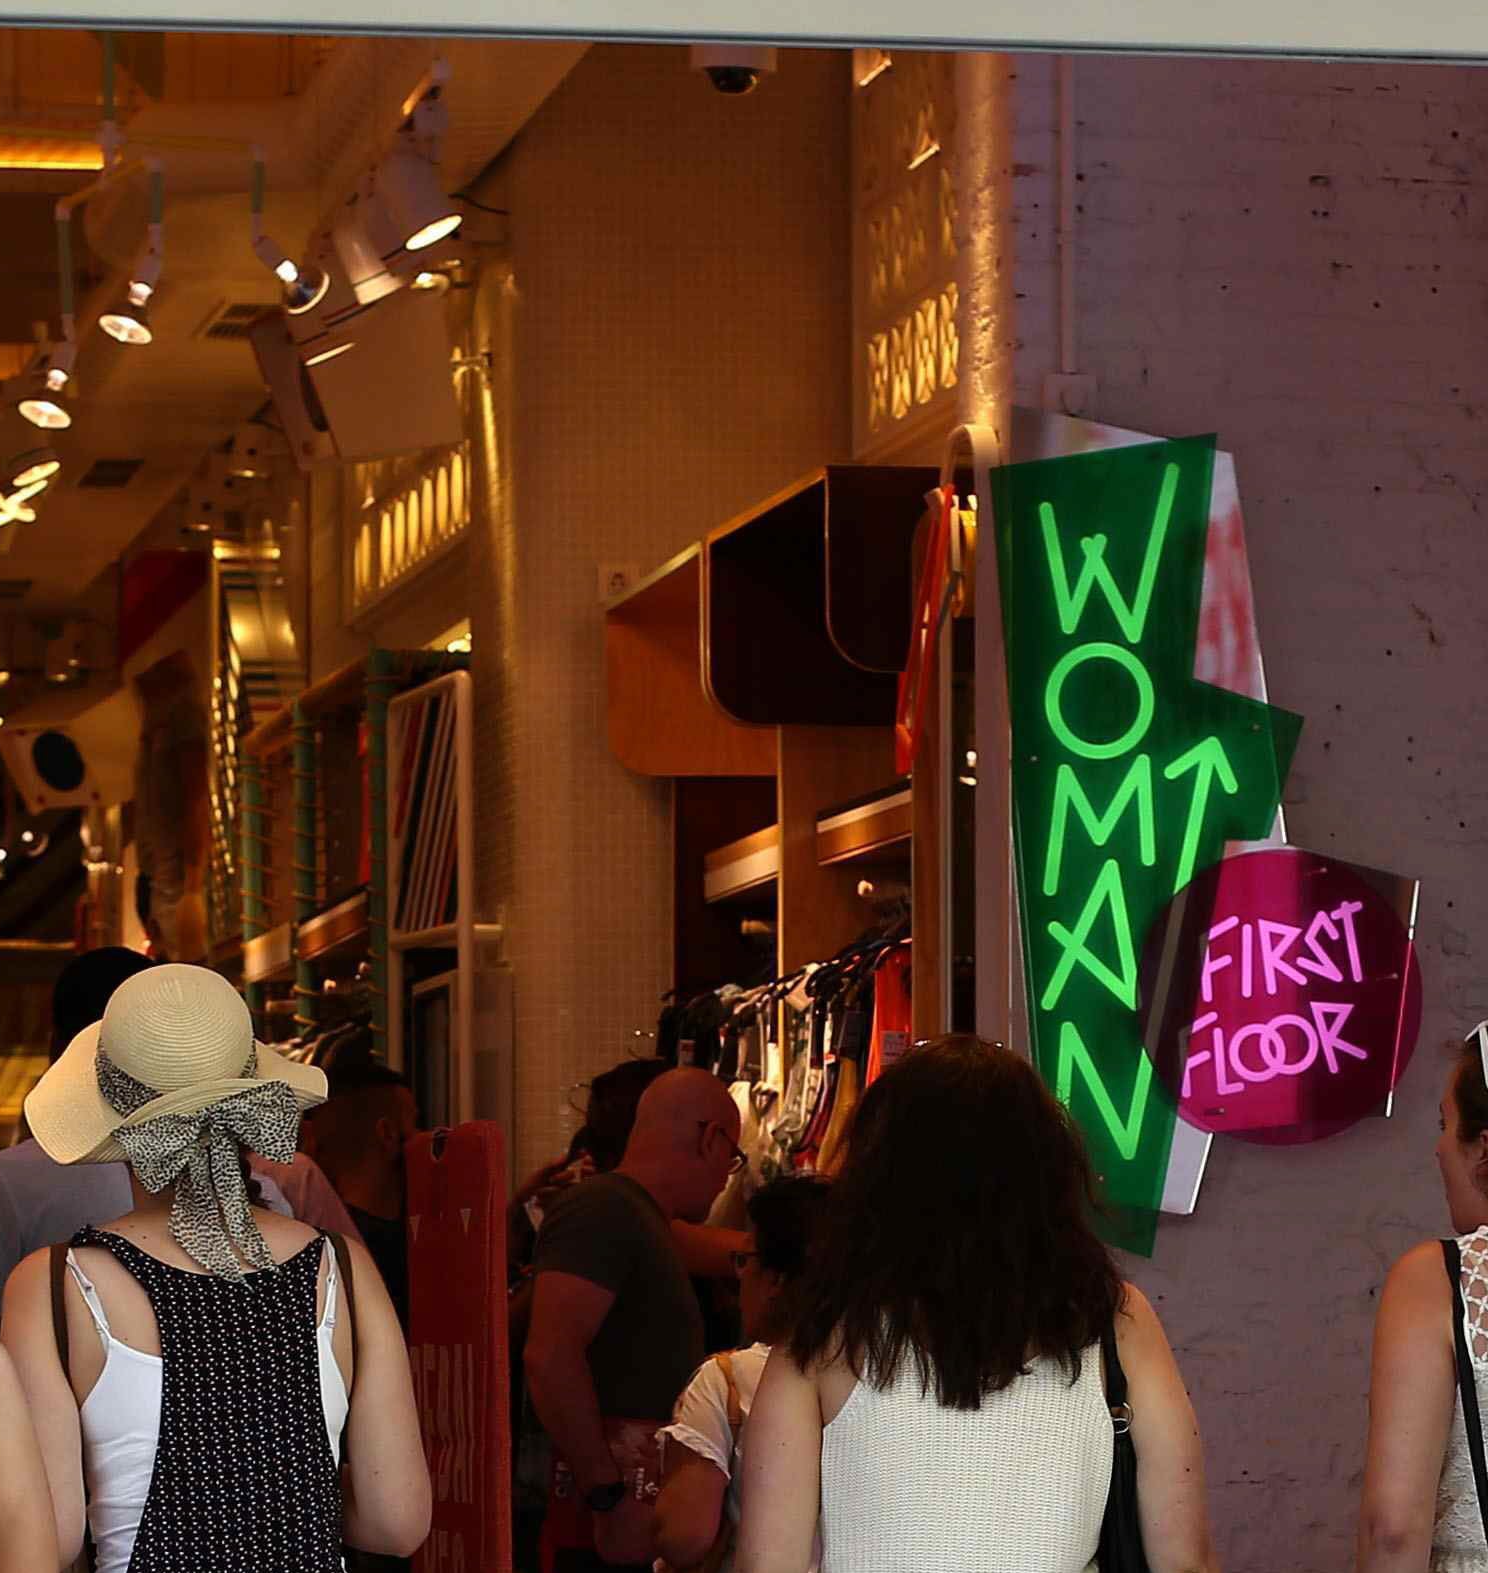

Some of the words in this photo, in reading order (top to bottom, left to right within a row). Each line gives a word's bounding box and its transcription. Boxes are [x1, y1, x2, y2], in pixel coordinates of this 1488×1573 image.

[1038, 463, 1180, 1162] WOMAN
[1200, 901, 1366, 1003] FIRST
[1180, 1001, 1368, 1100] FLOOR
